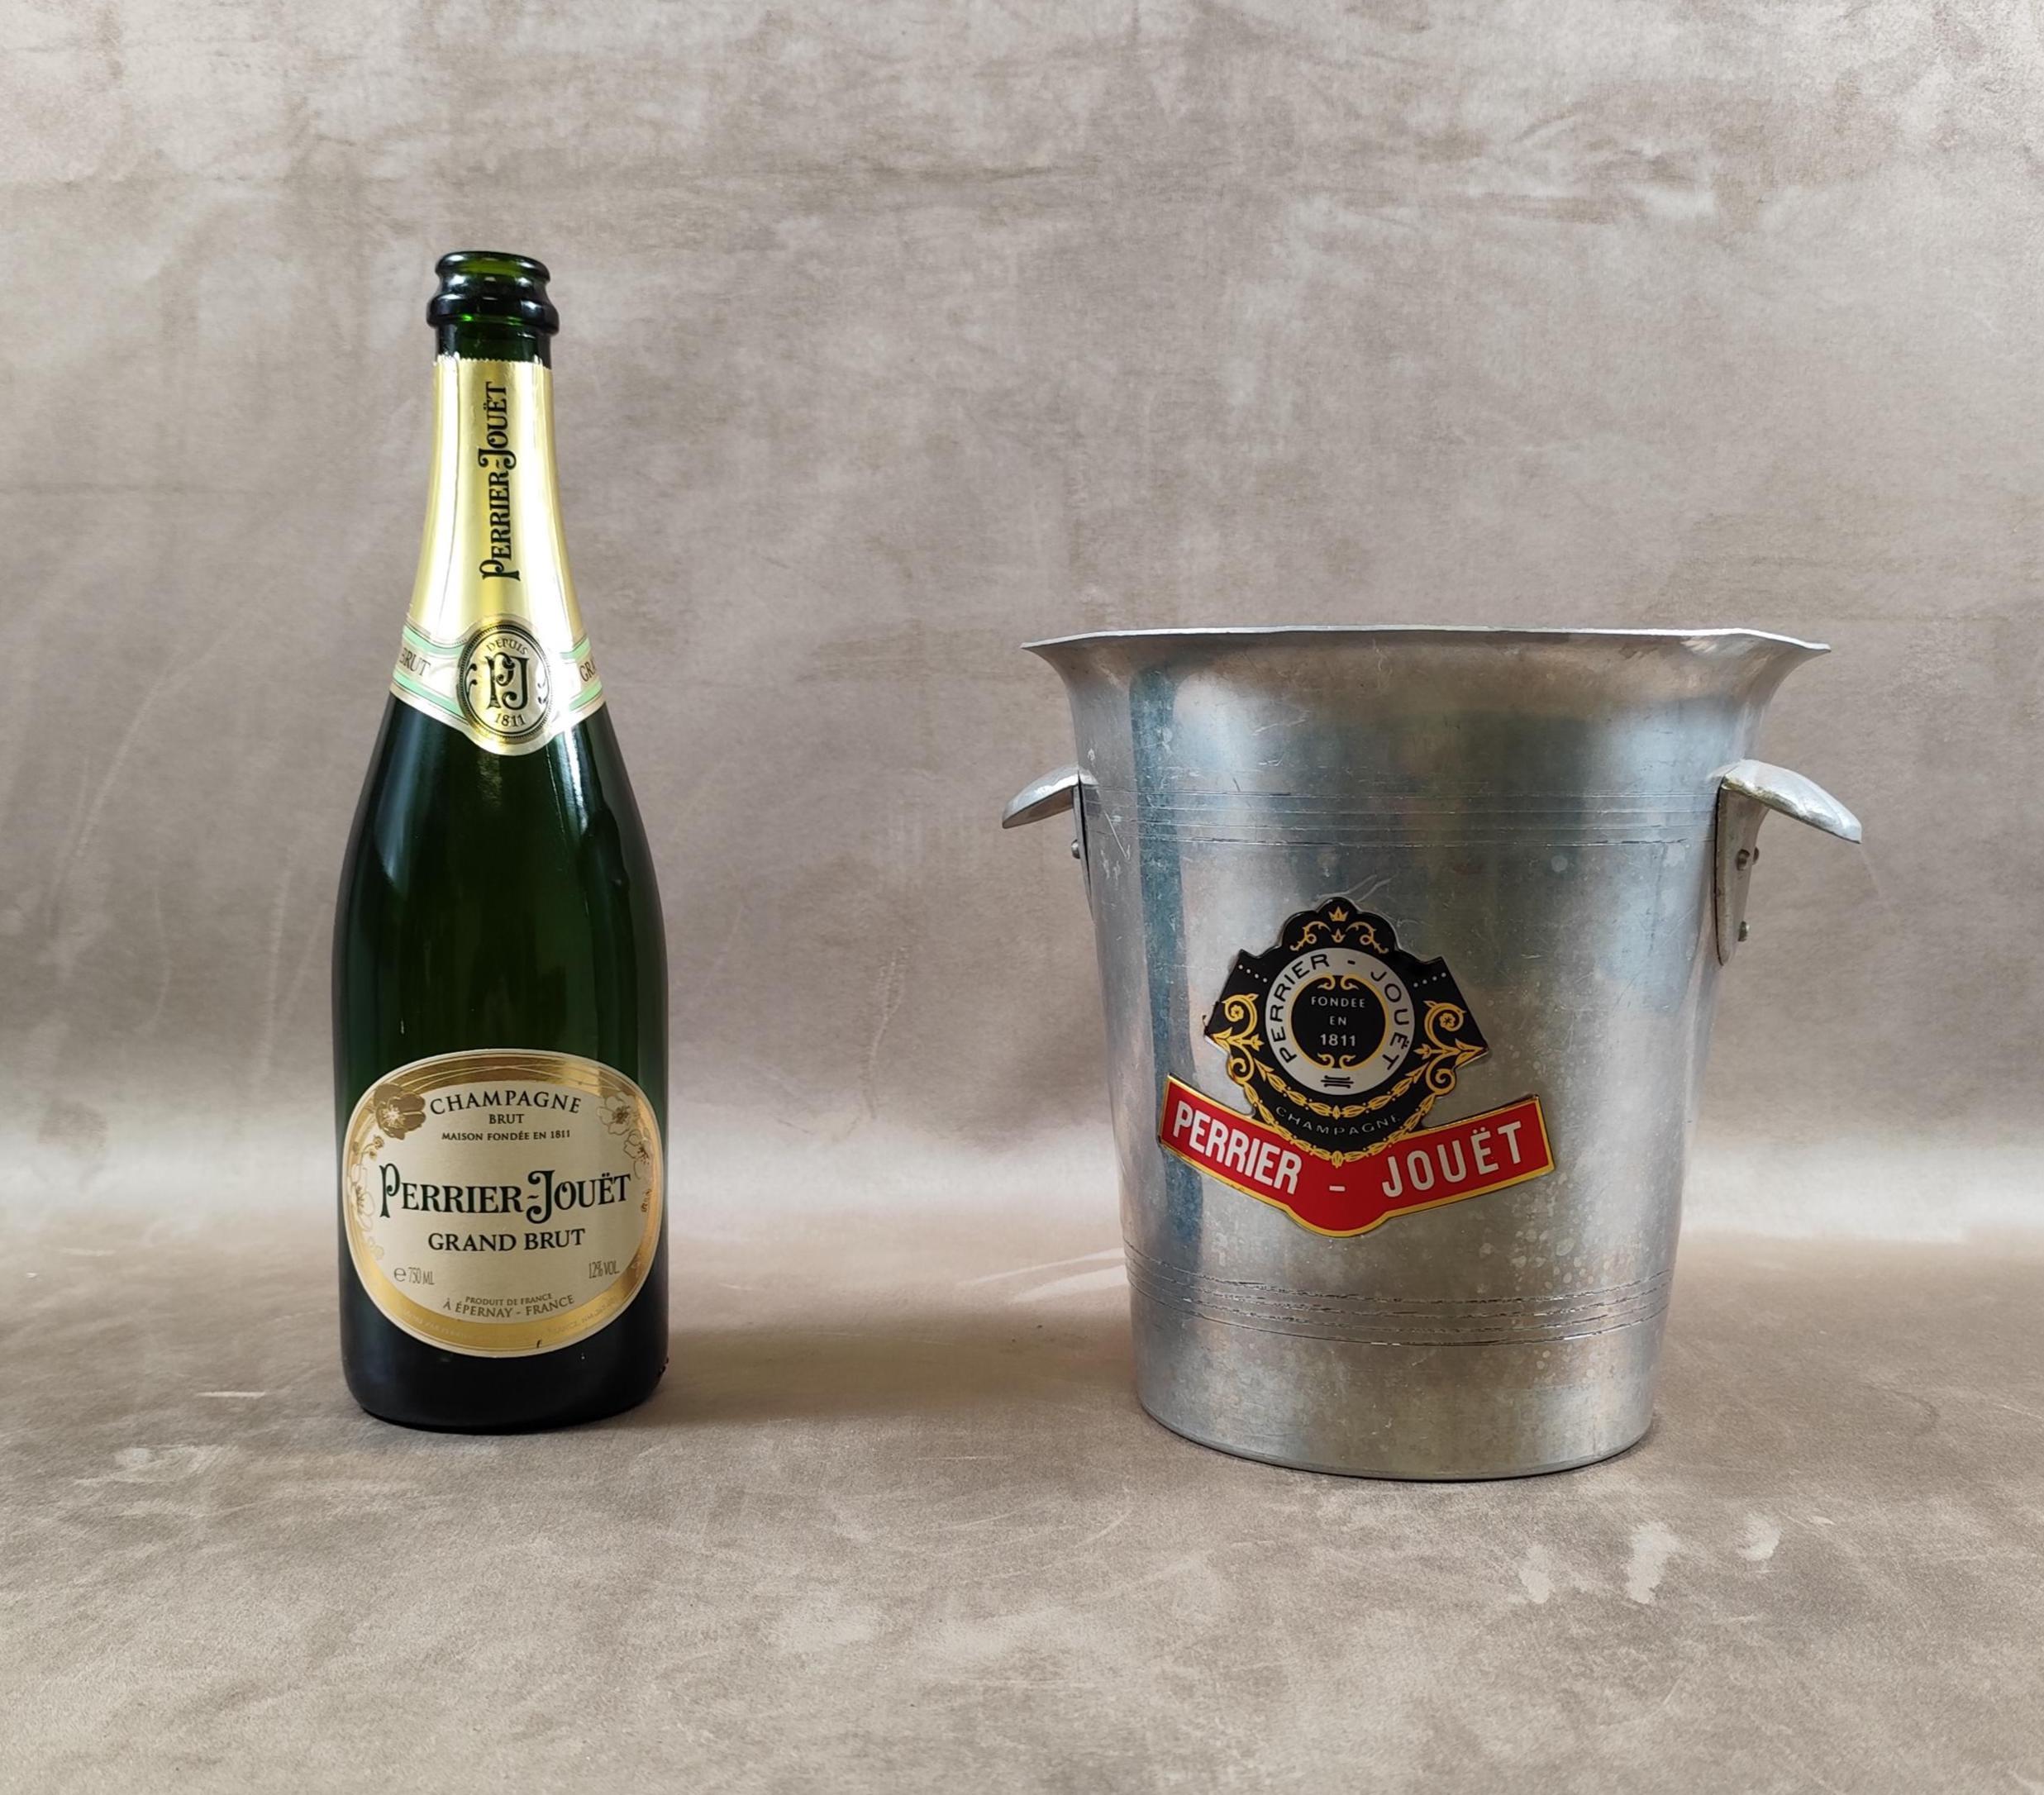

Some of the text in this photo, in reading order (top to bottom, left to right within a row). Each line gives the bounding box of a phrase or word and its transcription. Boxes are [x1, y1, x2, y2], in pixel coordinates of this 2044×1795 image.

[486, 638, 529, 655] DEPUIS
[495, 712, 526, 727] 1811
[1269, 953, 1331, 1064] PERRIER
[1370, 966, 1410, 1071] JOUËT
[1329, 1016, 1347, 1026] EN
[1320, 1033, 1356, 1047] 1811
[430, 1089, 582, 1115] CHAMPAGNE
[489, 1113, 525, 1125] BRUT
[441, 1130, 570, 1141] MAISON FONDÉE EN 1811
[1174, 1100, 1303, 1195] PERRIER
[1382, 1121, 1522, 1197] JOUËT
[427, 1228, 586, 1251] GRAND BRUT
[408, 1266, 422, 1284] 750
[455, 1302, 513, 1317] ÉPERNAY
[526, 1294, 574, 1316] FRANCE
[465, 1296, 504, 1306] PRODUIT
[521, 1293, 553, 1305] FRANCE
